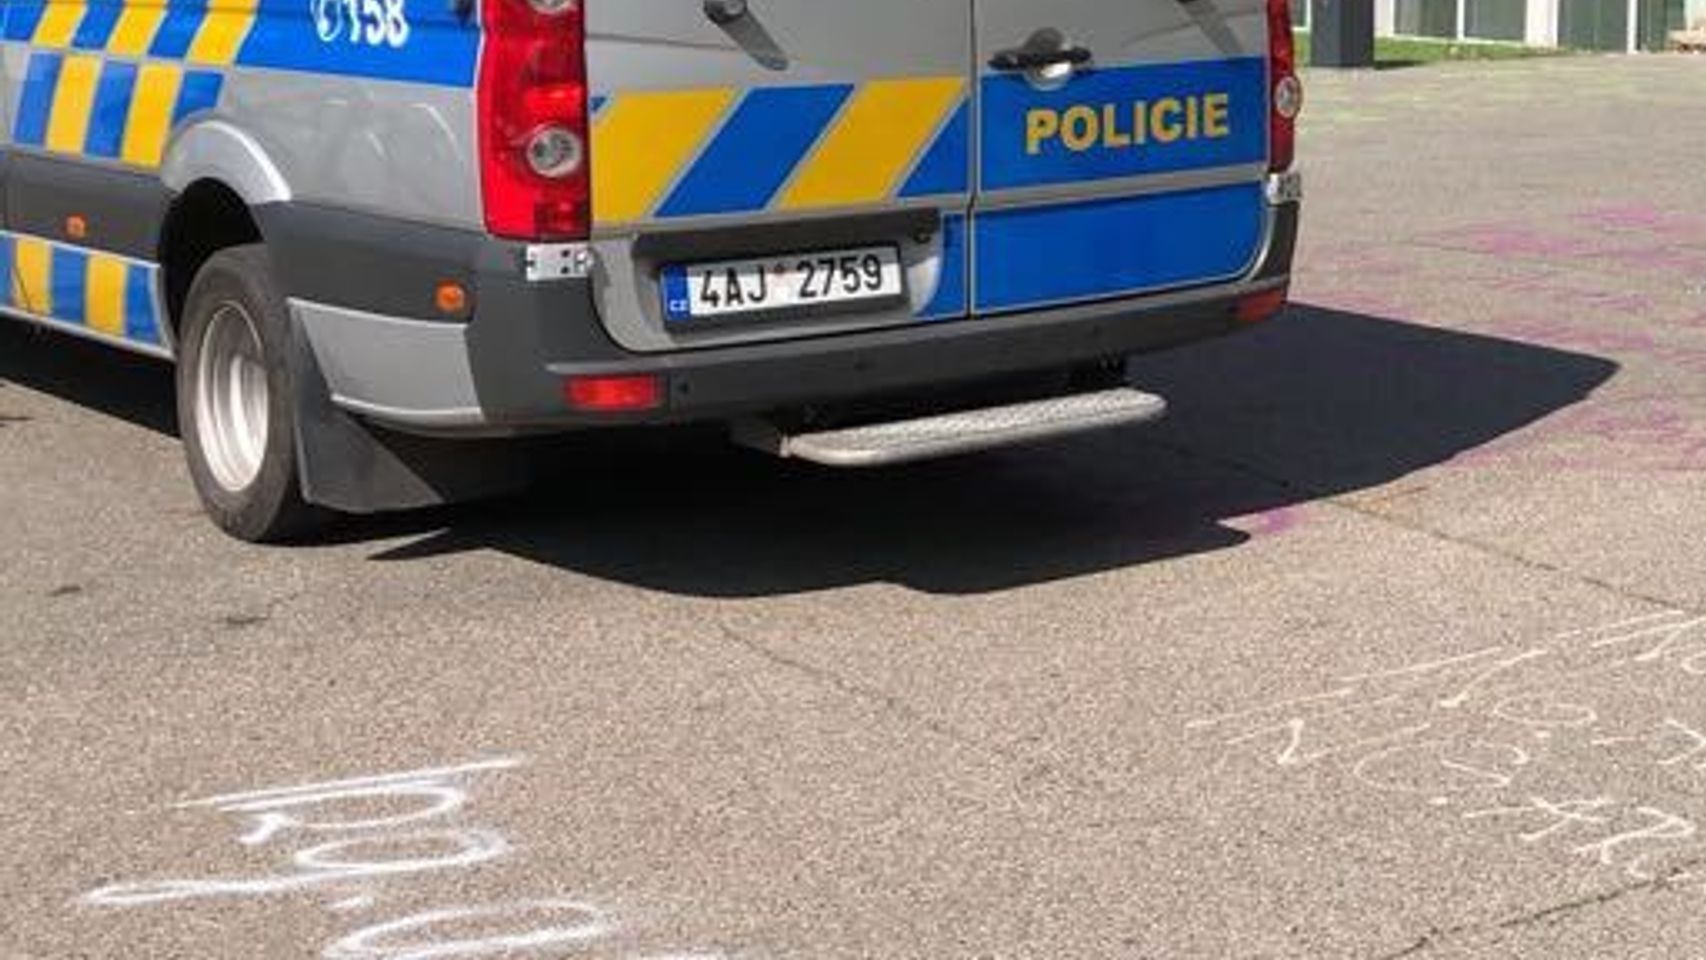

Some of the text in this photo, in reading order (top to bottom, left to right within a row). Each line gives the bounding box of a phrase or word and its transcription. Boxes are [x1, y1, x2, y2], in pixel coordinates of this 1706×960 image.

[1025, 93, 1230, 155] POLICIE
[699, 253, 882, 308] 4AJ 2759
